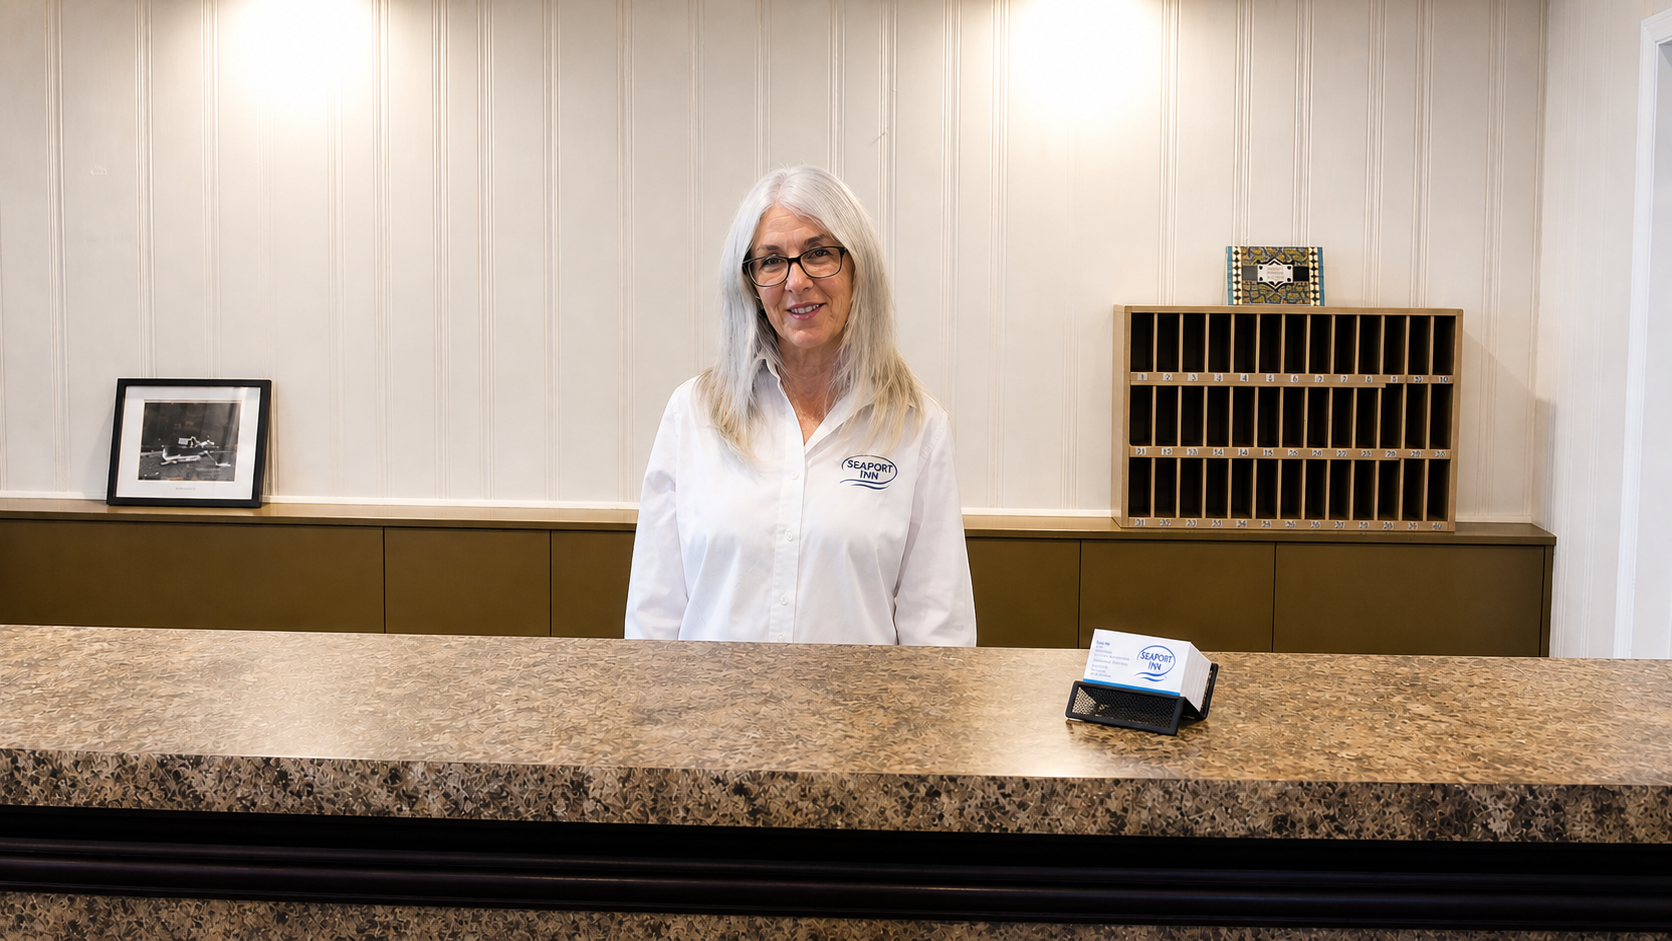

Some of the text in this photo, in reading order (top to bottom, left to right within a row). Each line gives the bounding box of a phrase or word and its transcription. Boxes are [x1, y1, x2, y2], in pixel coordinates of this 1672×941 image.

[847, 460, 893, 473] SEAPORT
[860, 470, 879, 480] INN
[1140, 651, 1173, 663] SEAPORT
